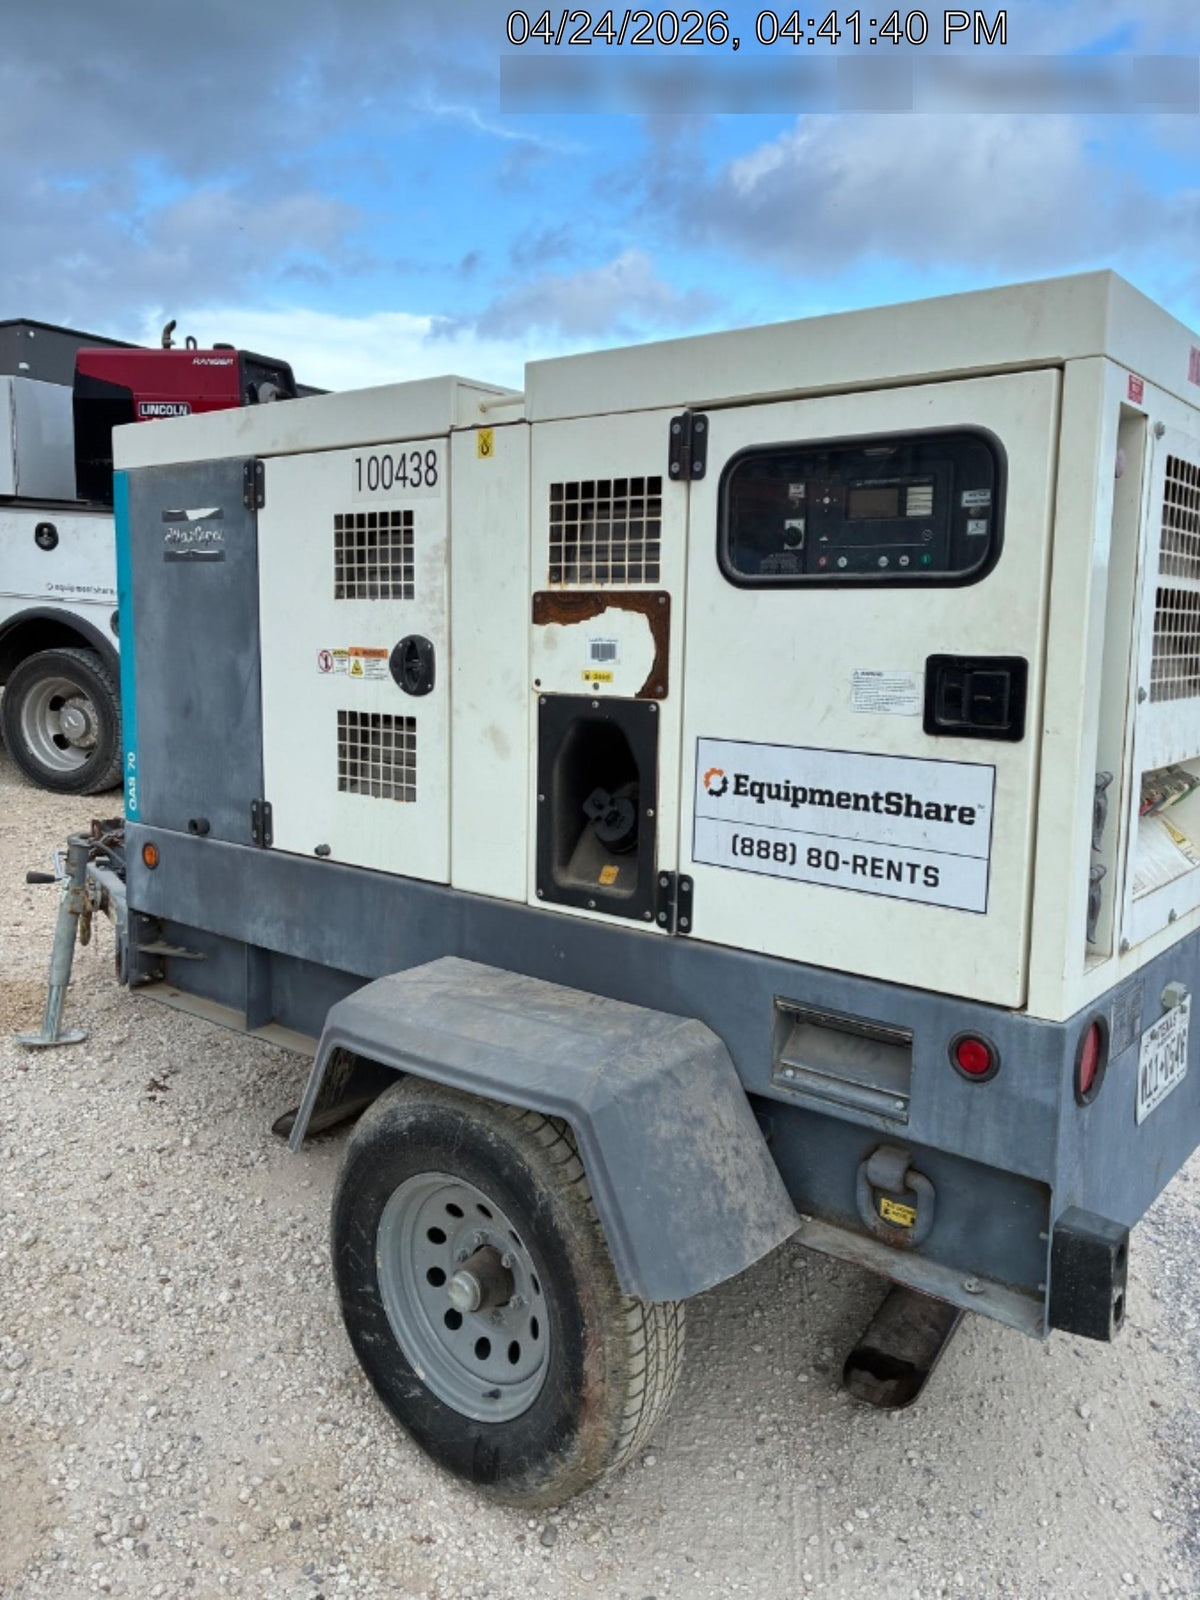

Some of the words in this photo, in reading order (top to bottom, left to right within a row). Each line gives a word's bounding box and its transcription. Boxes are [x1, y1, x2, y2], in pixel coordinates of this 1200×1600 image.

[141, 404, 188, 416] LINCOLN
[355, 449, 438, 492] 100438
[127, 752, 136, 772] 70
[733, 772, 976, 826] EquipmentShare
[732, 833, 797, 866] (888)
[806, 847, 940, 889] 80-RENTS
